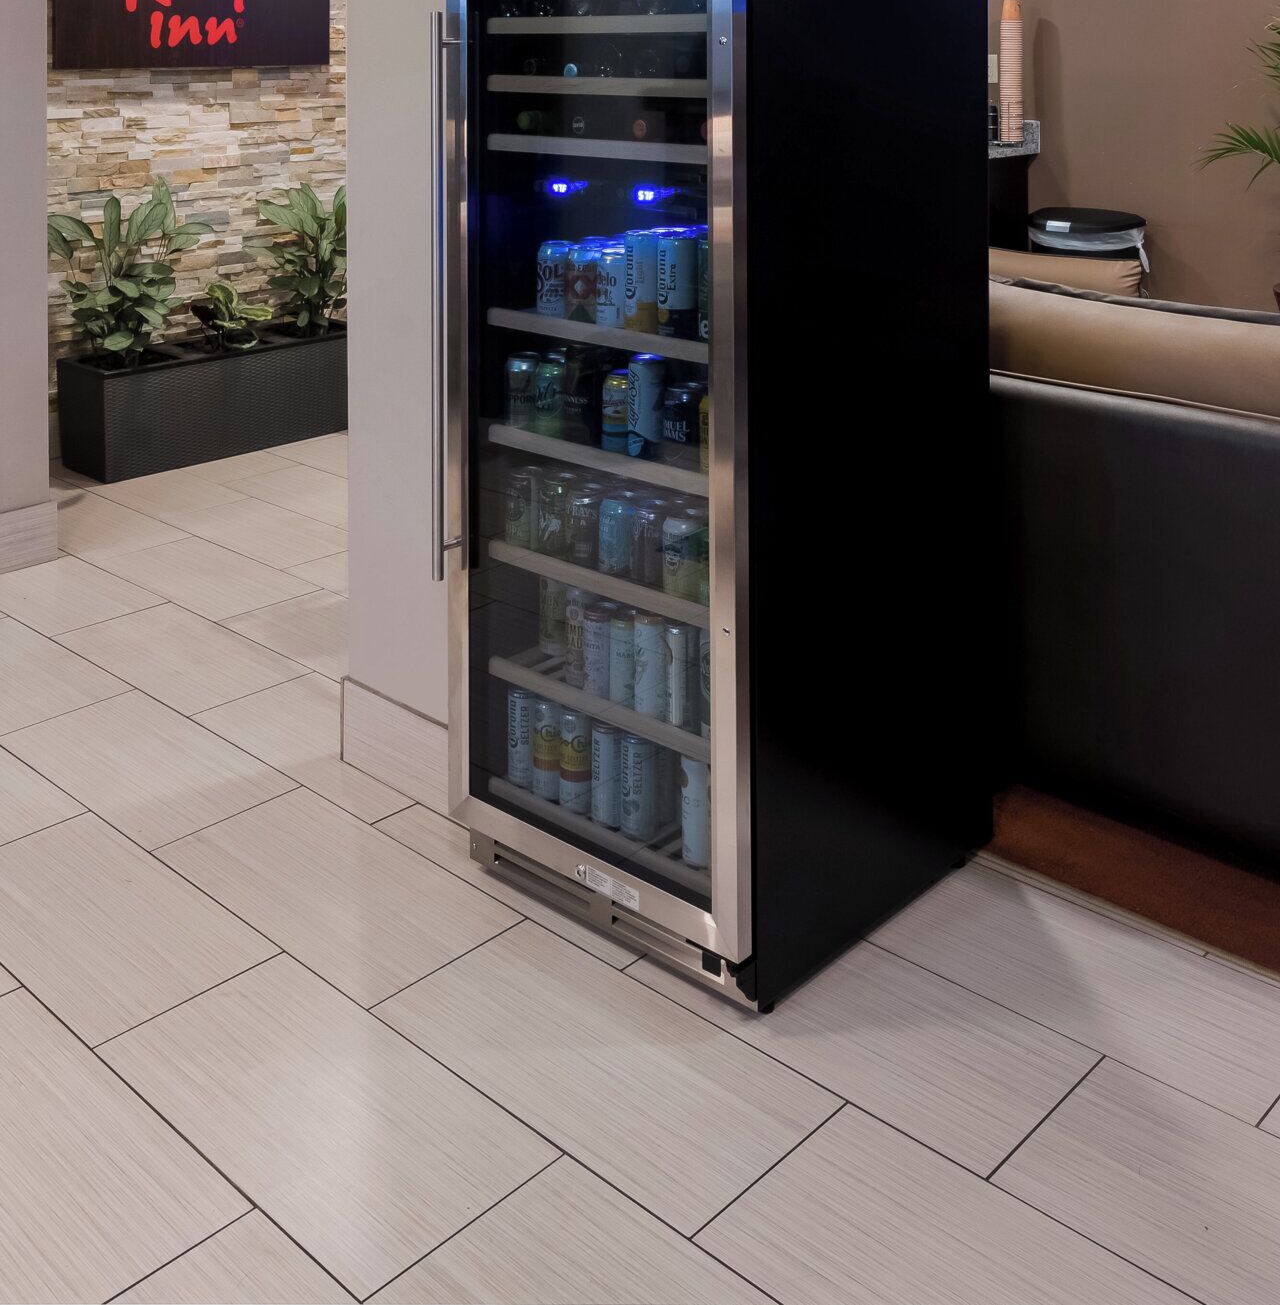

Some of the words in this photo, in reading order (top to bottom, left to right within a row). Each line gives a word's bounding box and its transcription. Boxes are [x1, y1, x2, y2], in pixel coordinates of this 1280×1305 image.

[625, 246, 636, 300] Corona
[658, 249, 669, 305] Corona
[667, 263, 677, 291] Extra
[664, 418, 690, 433] MUEL
[510, 699, 520, 749] Corona
[521, 706, 530, 746] SELTZER
[592, 738, 601, 783] SELTZER
[621, 745, 630, 798] Corona
[633, 752, 643, 796] SELTZER
